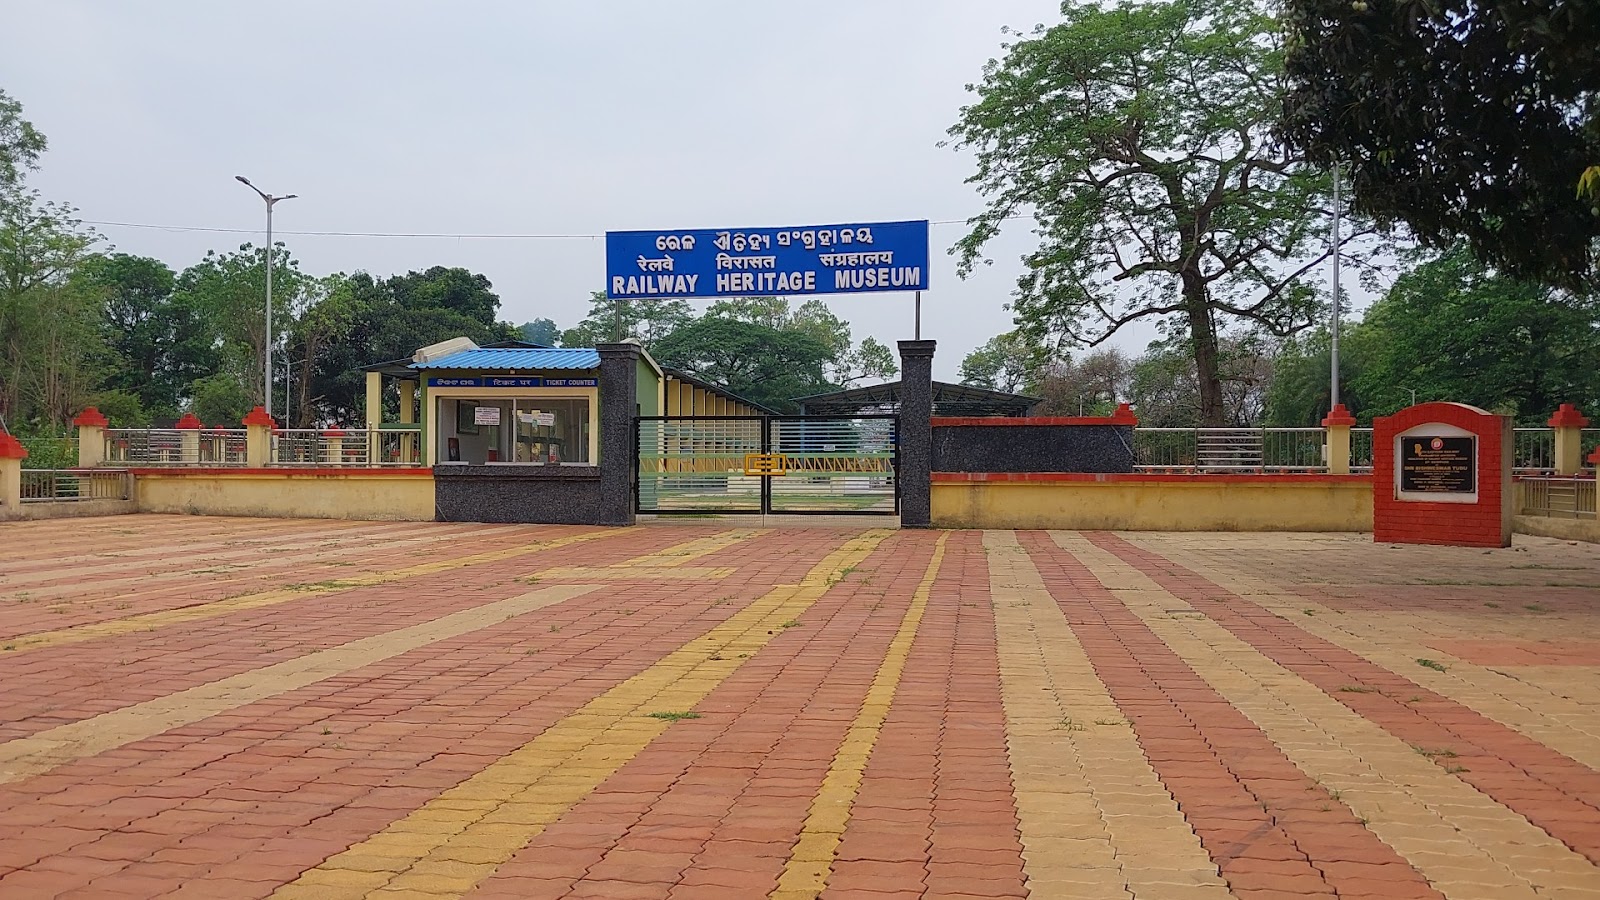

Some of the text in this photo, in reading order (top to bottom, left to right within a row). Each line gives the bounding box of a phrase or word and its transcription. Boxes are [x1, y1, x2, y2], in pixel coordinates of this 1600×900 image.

[636, 248, 893, 272] रेलवे विरासत संग्रहालय
[612, 267, 920, 295] RAILWAY HERITAGE MUSEUM
[493, 378, 516, 386] टिकट
